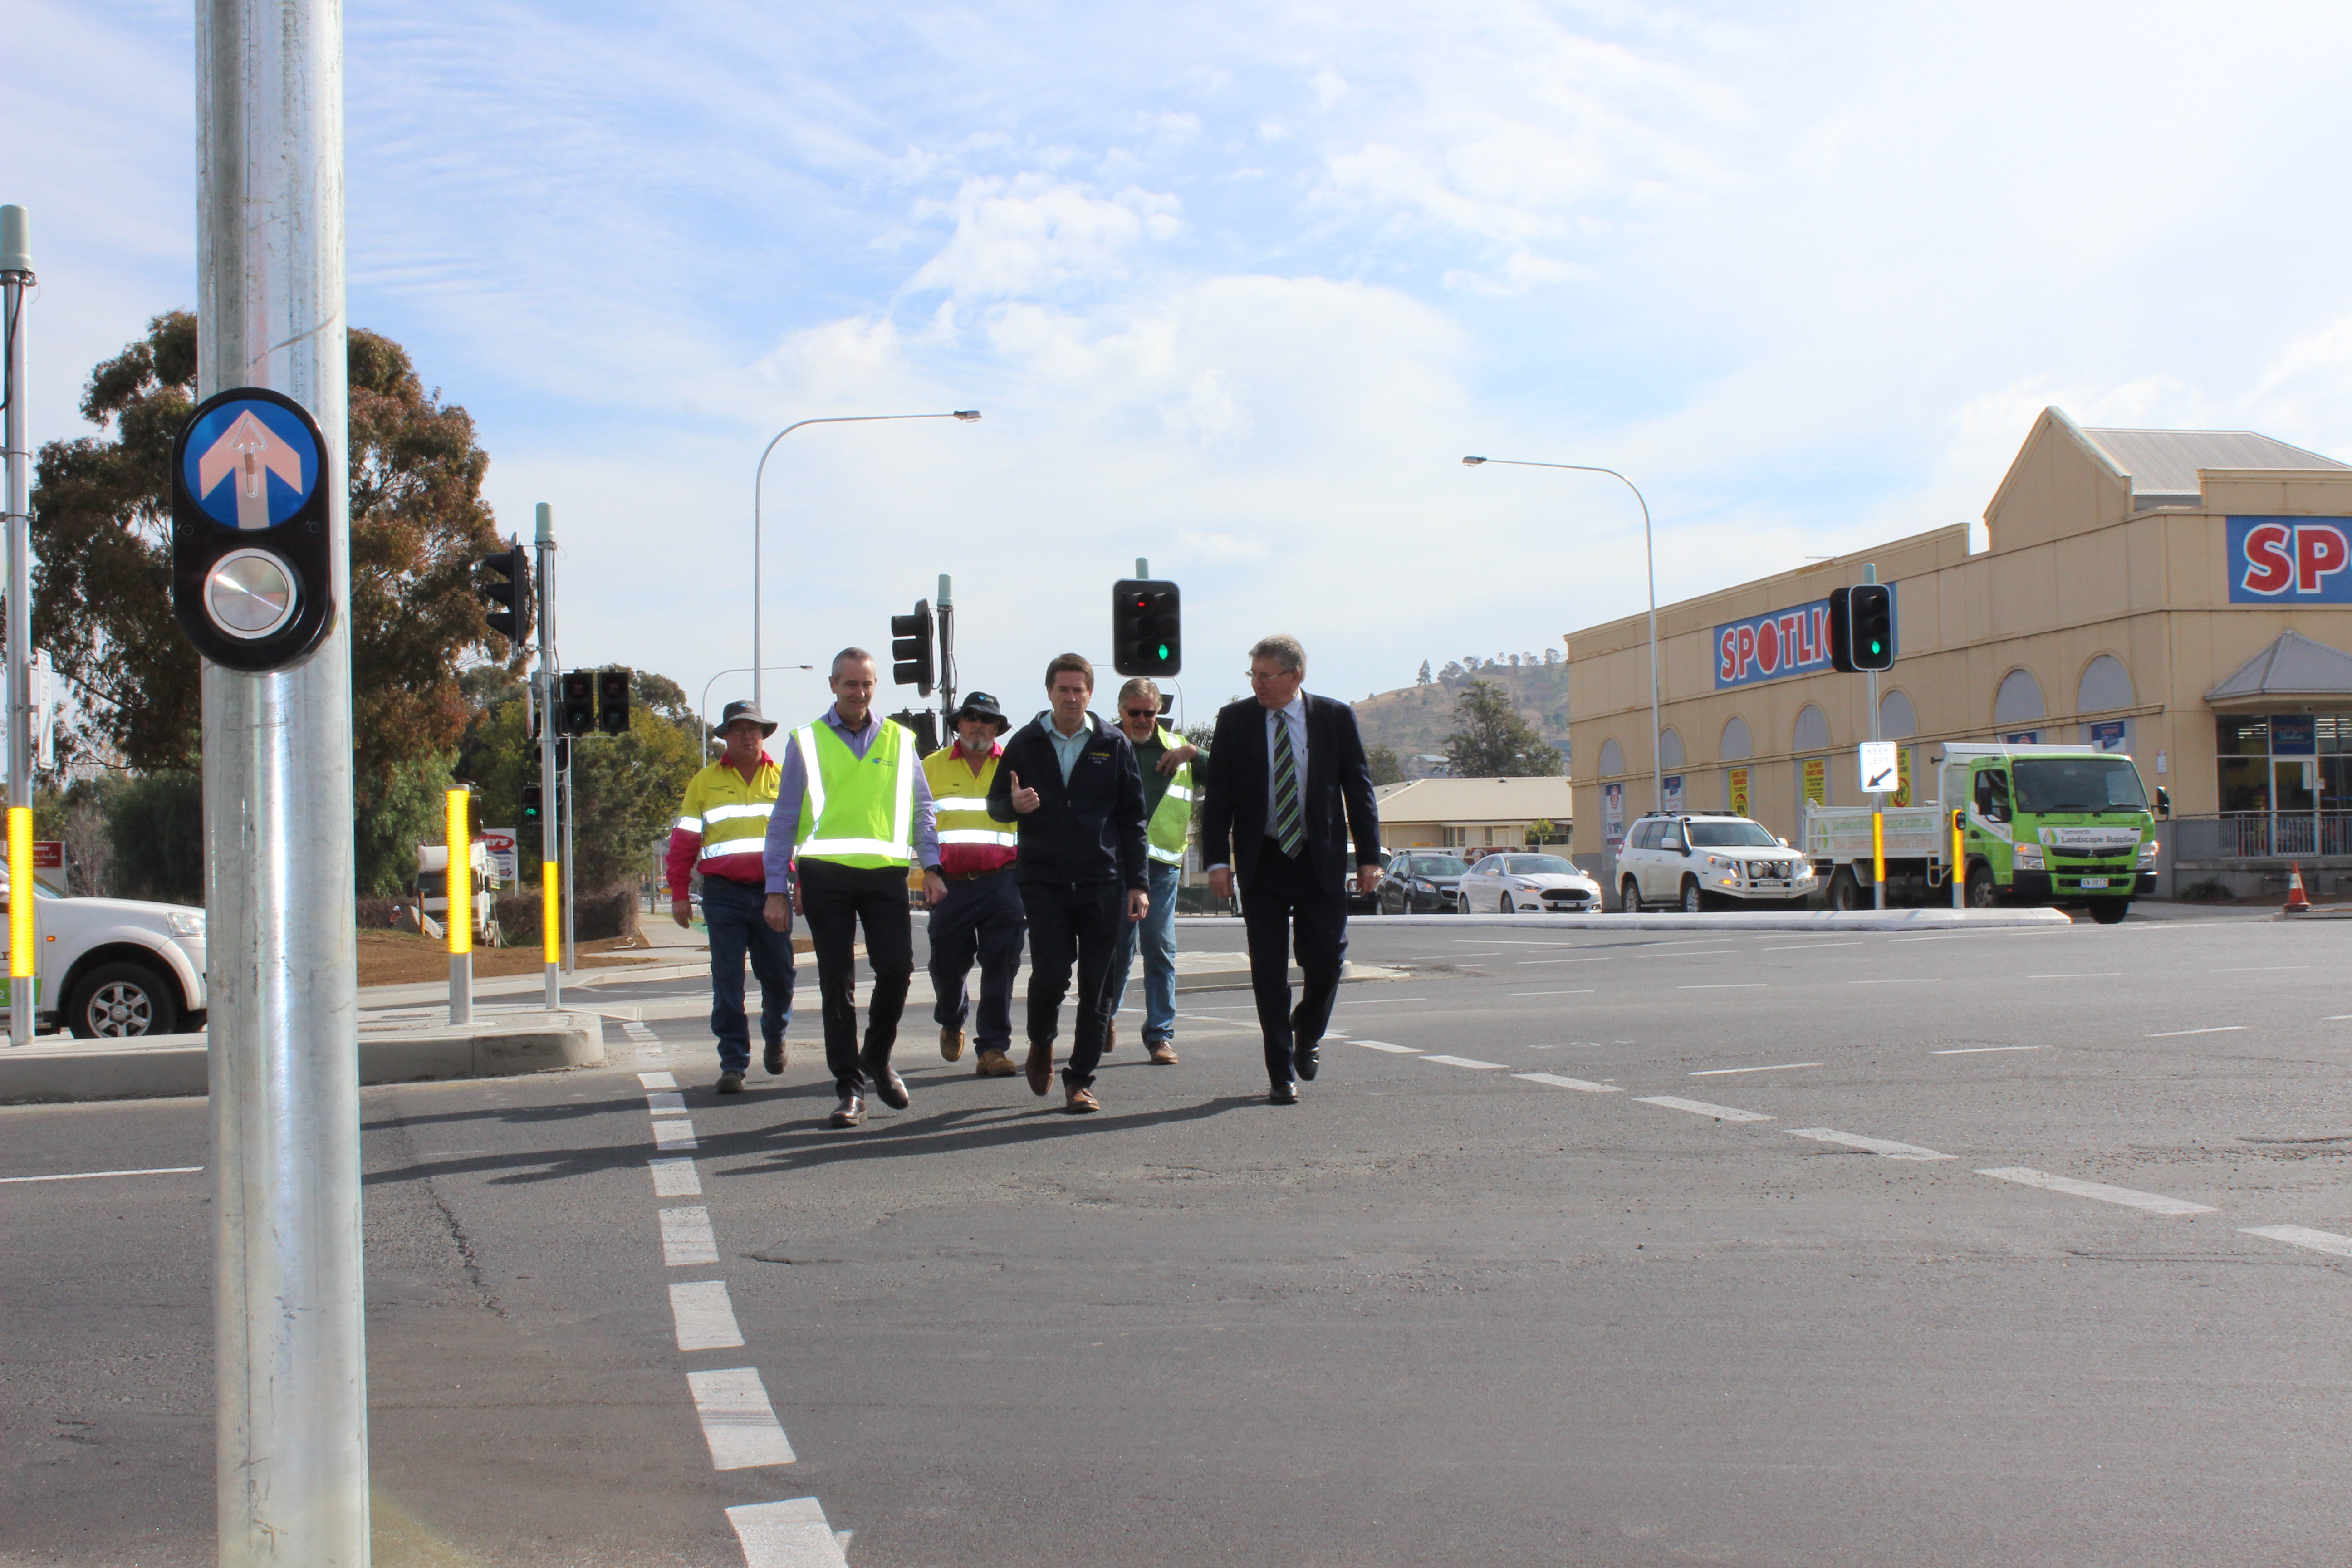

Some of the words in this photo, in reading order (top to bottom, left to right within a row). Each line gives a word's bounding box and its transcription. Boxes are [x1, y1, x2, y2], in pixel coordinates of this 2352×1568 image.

[2241, 523, 2352, 595] SP
[1720, 607, 1832, 681] SPOTLI
[1833, 818, 1932, 831] tamworthlascape.com.au
[1912, 837, 1932, 848] Centre
[2061, 835, 2103, 844] Landscape
[2106, 835, 2137, 844] Supplies
